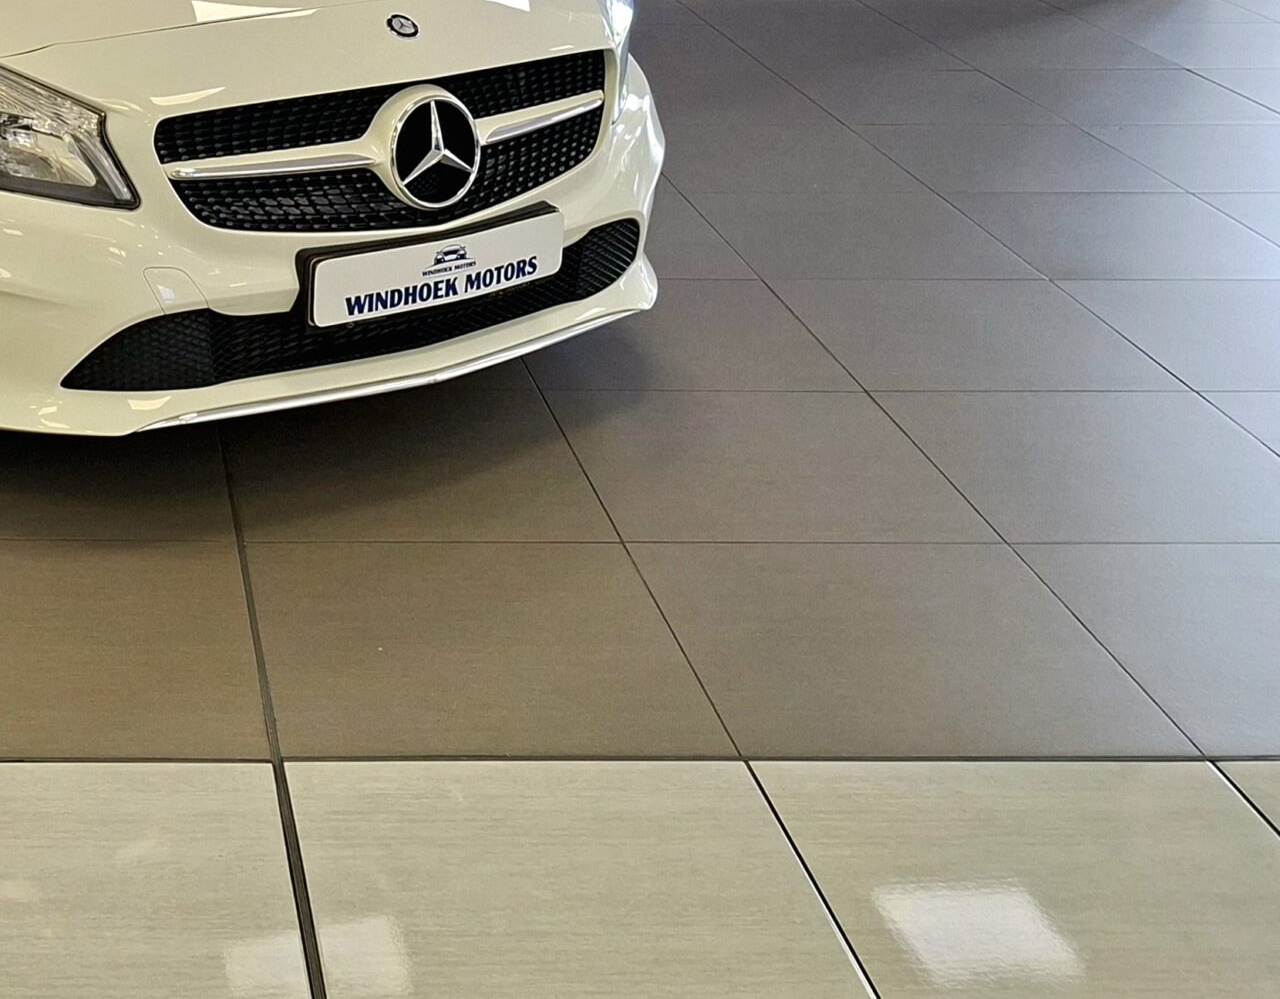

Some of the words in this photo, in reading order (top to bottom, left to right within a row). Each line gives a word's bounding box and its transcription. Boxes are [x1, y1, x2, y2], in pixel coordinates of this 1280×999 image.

[345, 277, 459, 316] WINDHOEK
[464, 256, 538, 293] MOTORS
[422, 266, 453, 277] WINDHOEK
[454, 261, 477, 271] MOTORS
